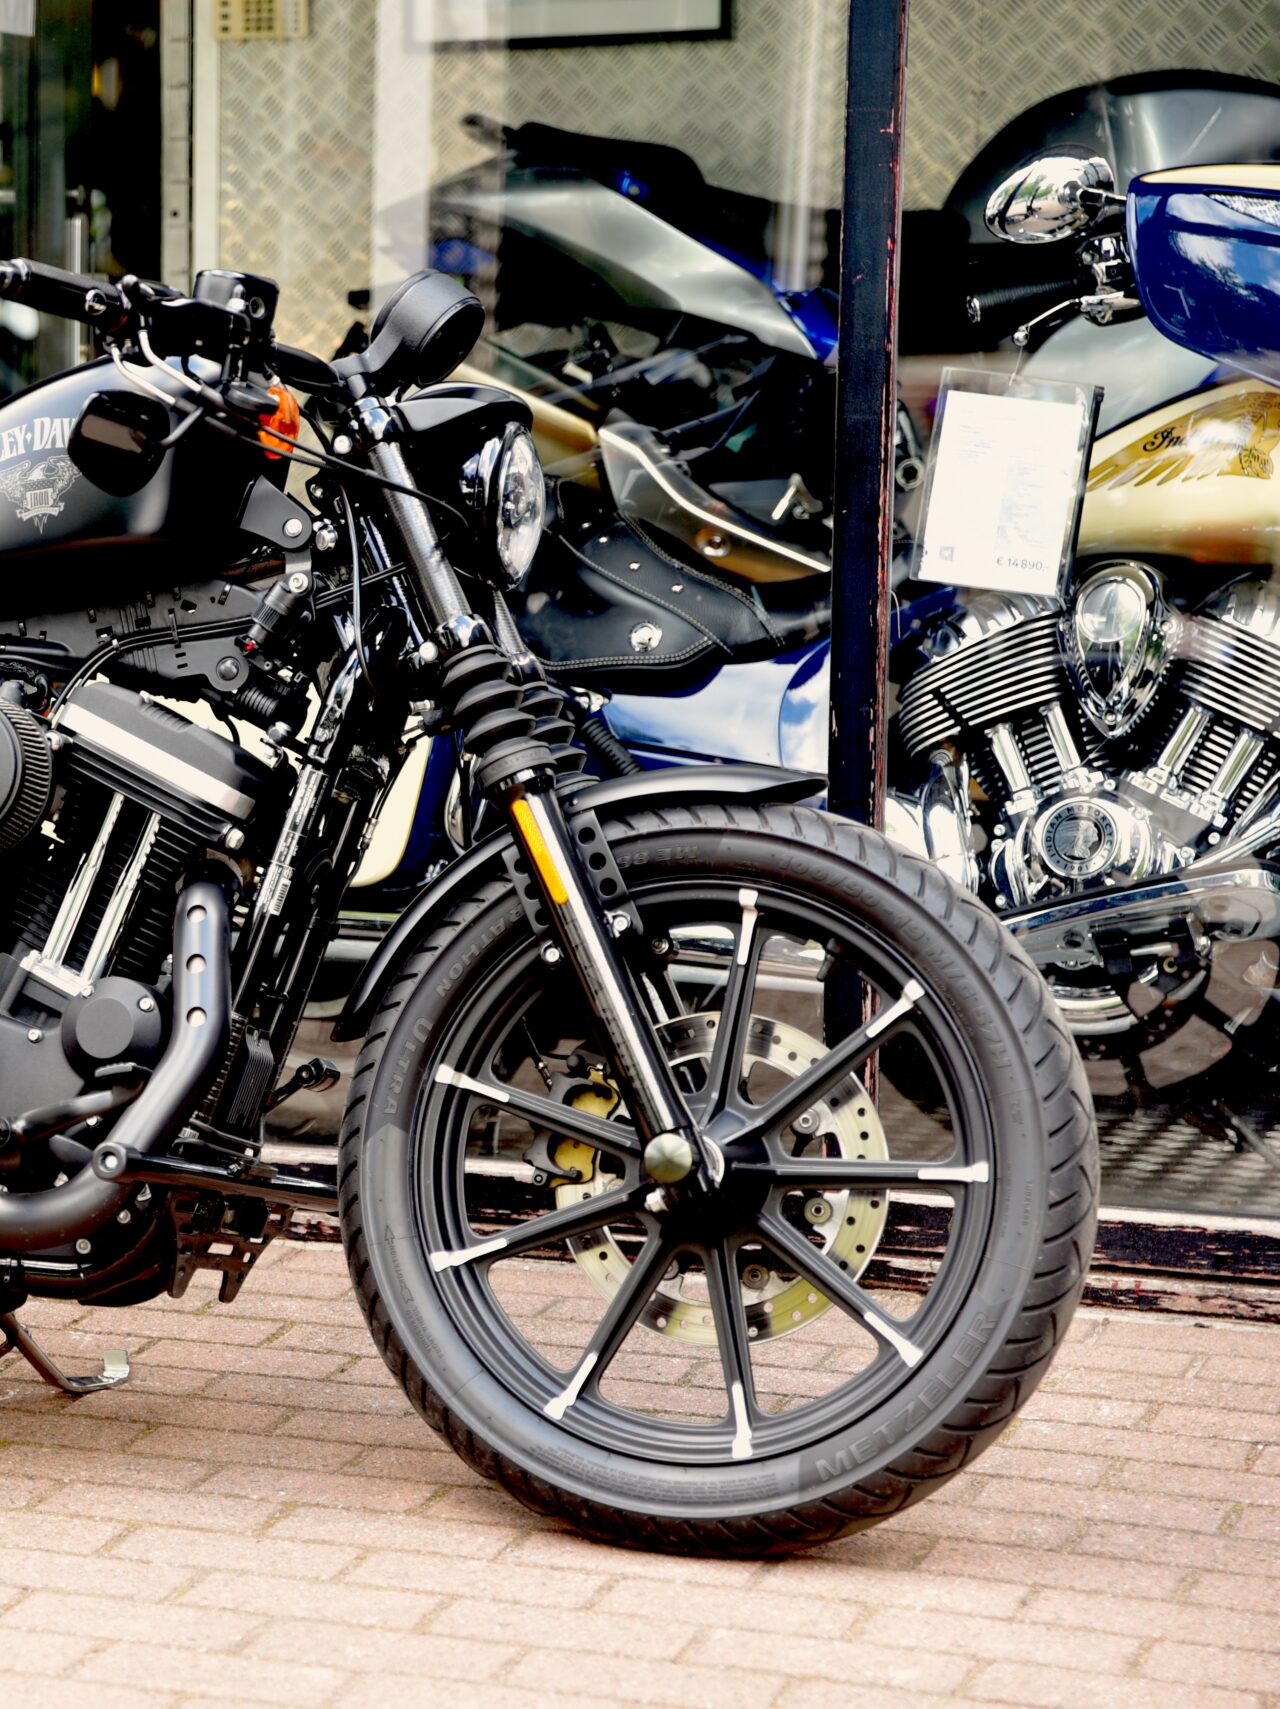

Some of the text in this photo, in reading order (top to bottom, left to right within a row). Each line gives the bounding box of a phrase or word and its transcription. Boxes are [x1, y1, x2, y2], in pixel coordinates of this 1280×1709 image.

[1045, 813, 1063, 858] INDIAN
[383, 1016, 434, 1114] ULTRA
[815, 1311, 997, 1482] METZELER
